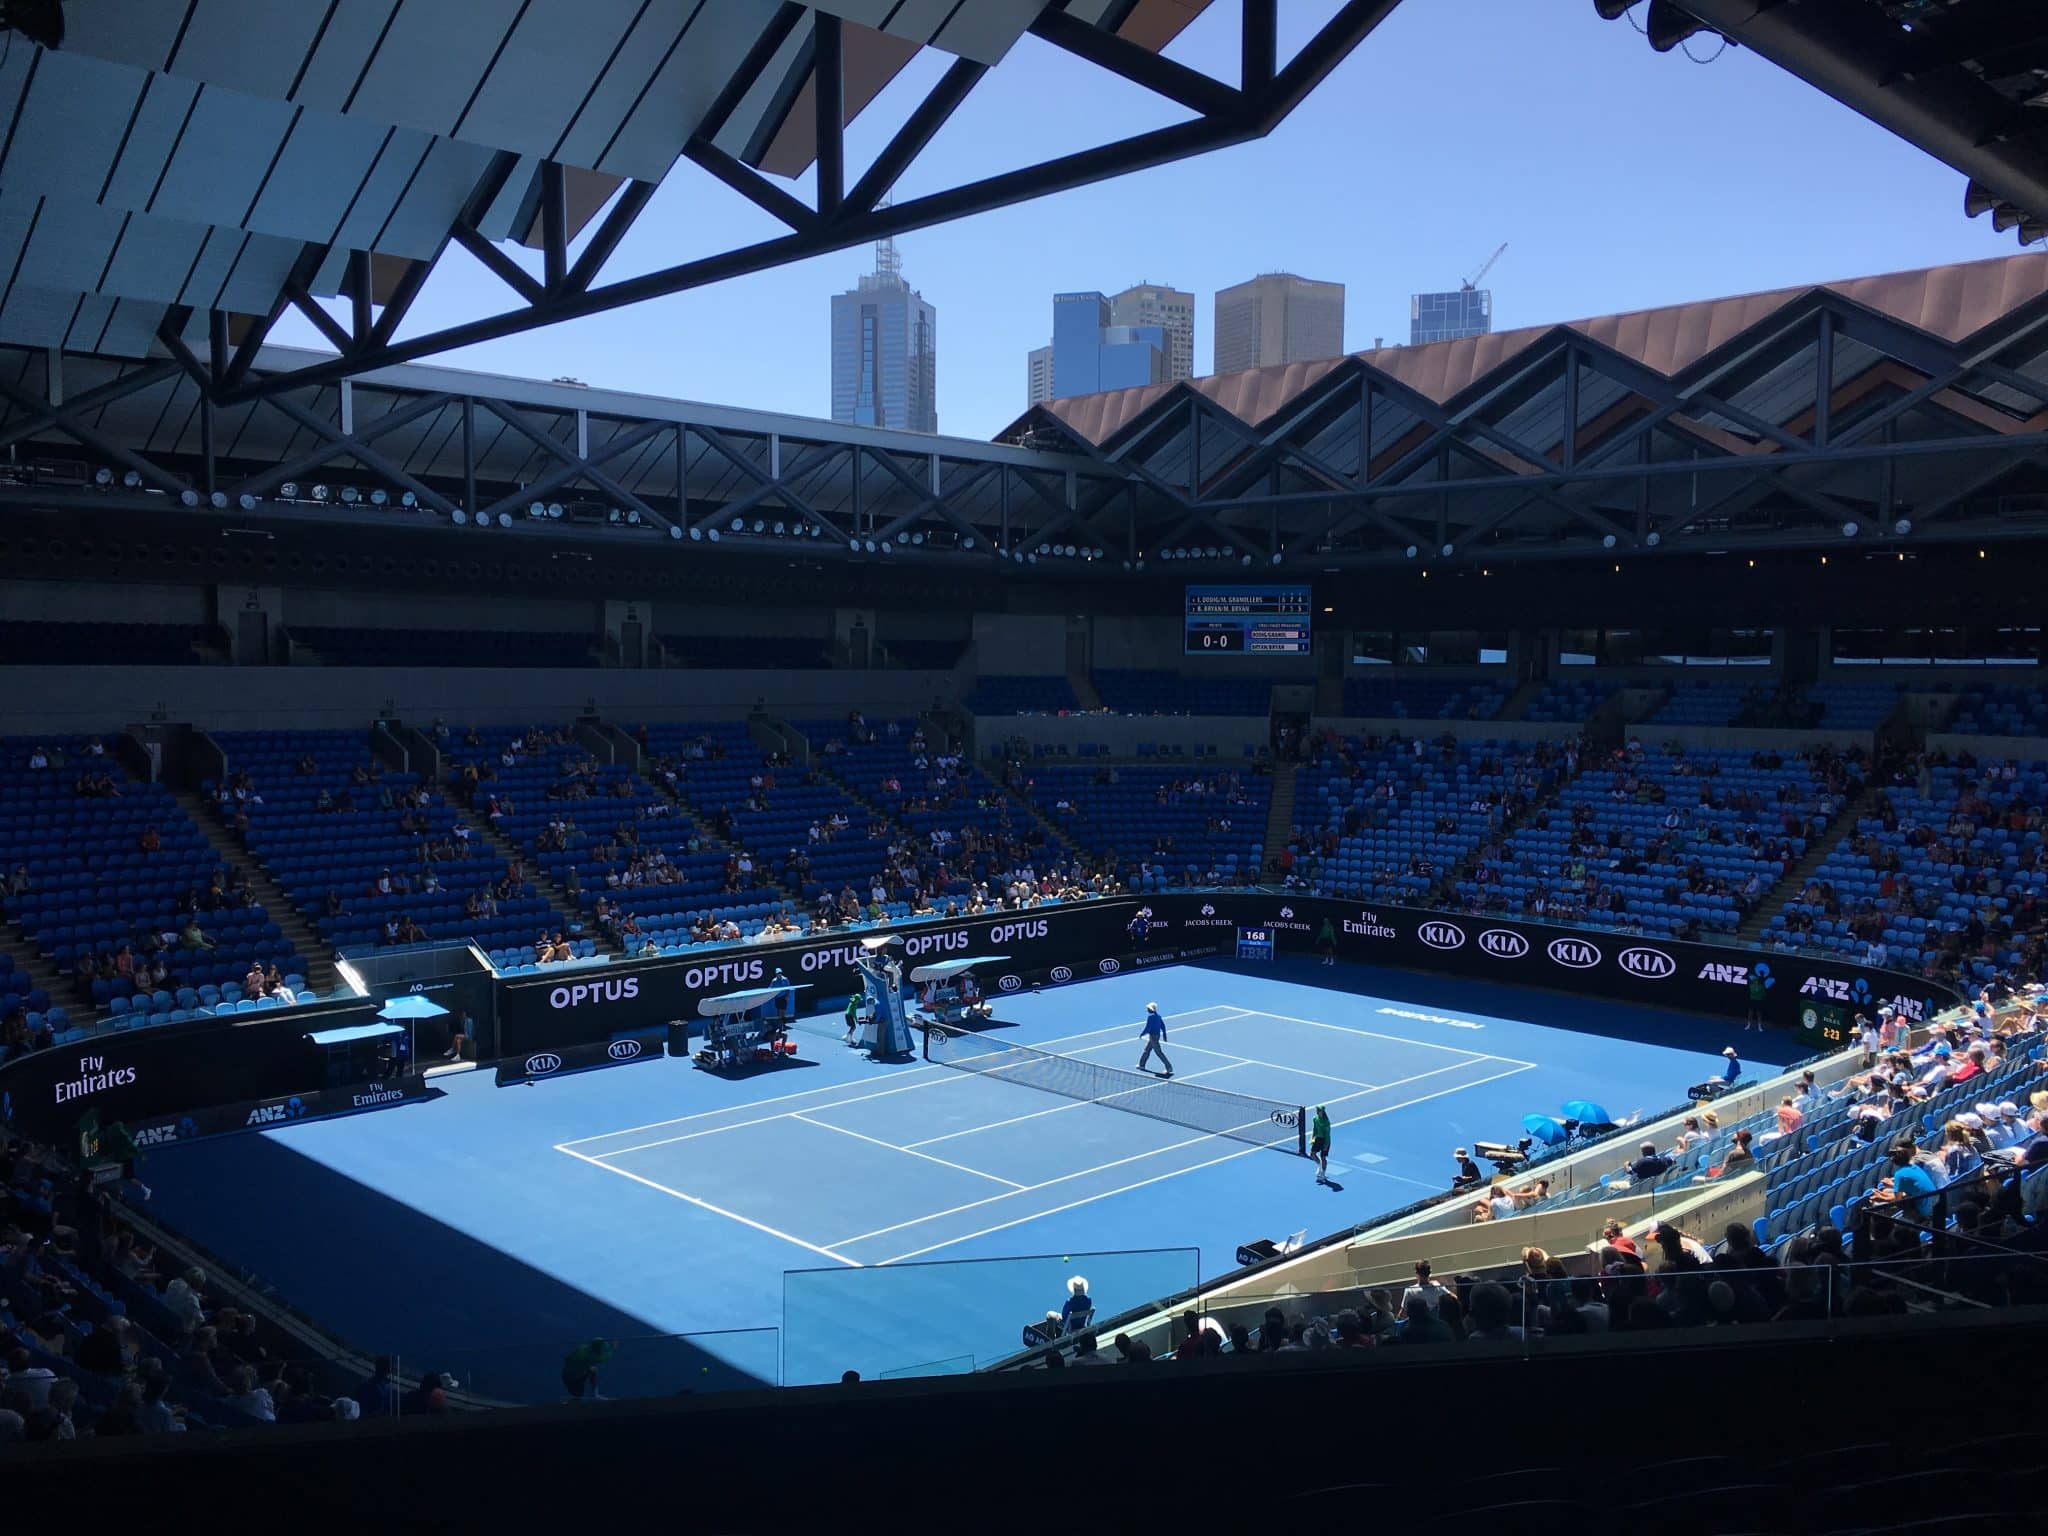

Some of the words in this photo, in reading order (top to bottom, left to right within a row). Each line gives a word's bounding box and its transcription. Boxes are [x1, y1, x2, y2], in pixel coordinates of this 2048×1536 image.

[1343, 919, 1397, 938] Emirates
[1361, 911, 1377, 924] Fly
[990, 919, 1048, 944] OPTUS
[1246, 931, 1265, 940] 168
[1425, 925, 1459, 945] KIA
[905, 930, 969, 956] OPTUS
[1486, 934, 1521, 954] KIA
[1556, 943, 1593, 963] KIA
[1627, 952, 1666, 974] KIA
[1697, 962, 1748, 985] ANZ
[685, 960, 764, 989] OPTUS
[549, 977, 640, 1009] OPTUS
[1799, 976, 1850, 1001] ANZ
[1890, 994, 1923, 1022] ANZ
[1823, 1027, 1841, 1041] 2:23
[79, 1055, 104, 1073] Fly
[54, 1066, 137, 1104] Emirates
[369, 1082, 384, 1092] Fly
[352, 1089, 404, 1107] Emirates
[245, 1104, 287, 1126] ANZ
[132, 1124, 177, 1147] ANZ
